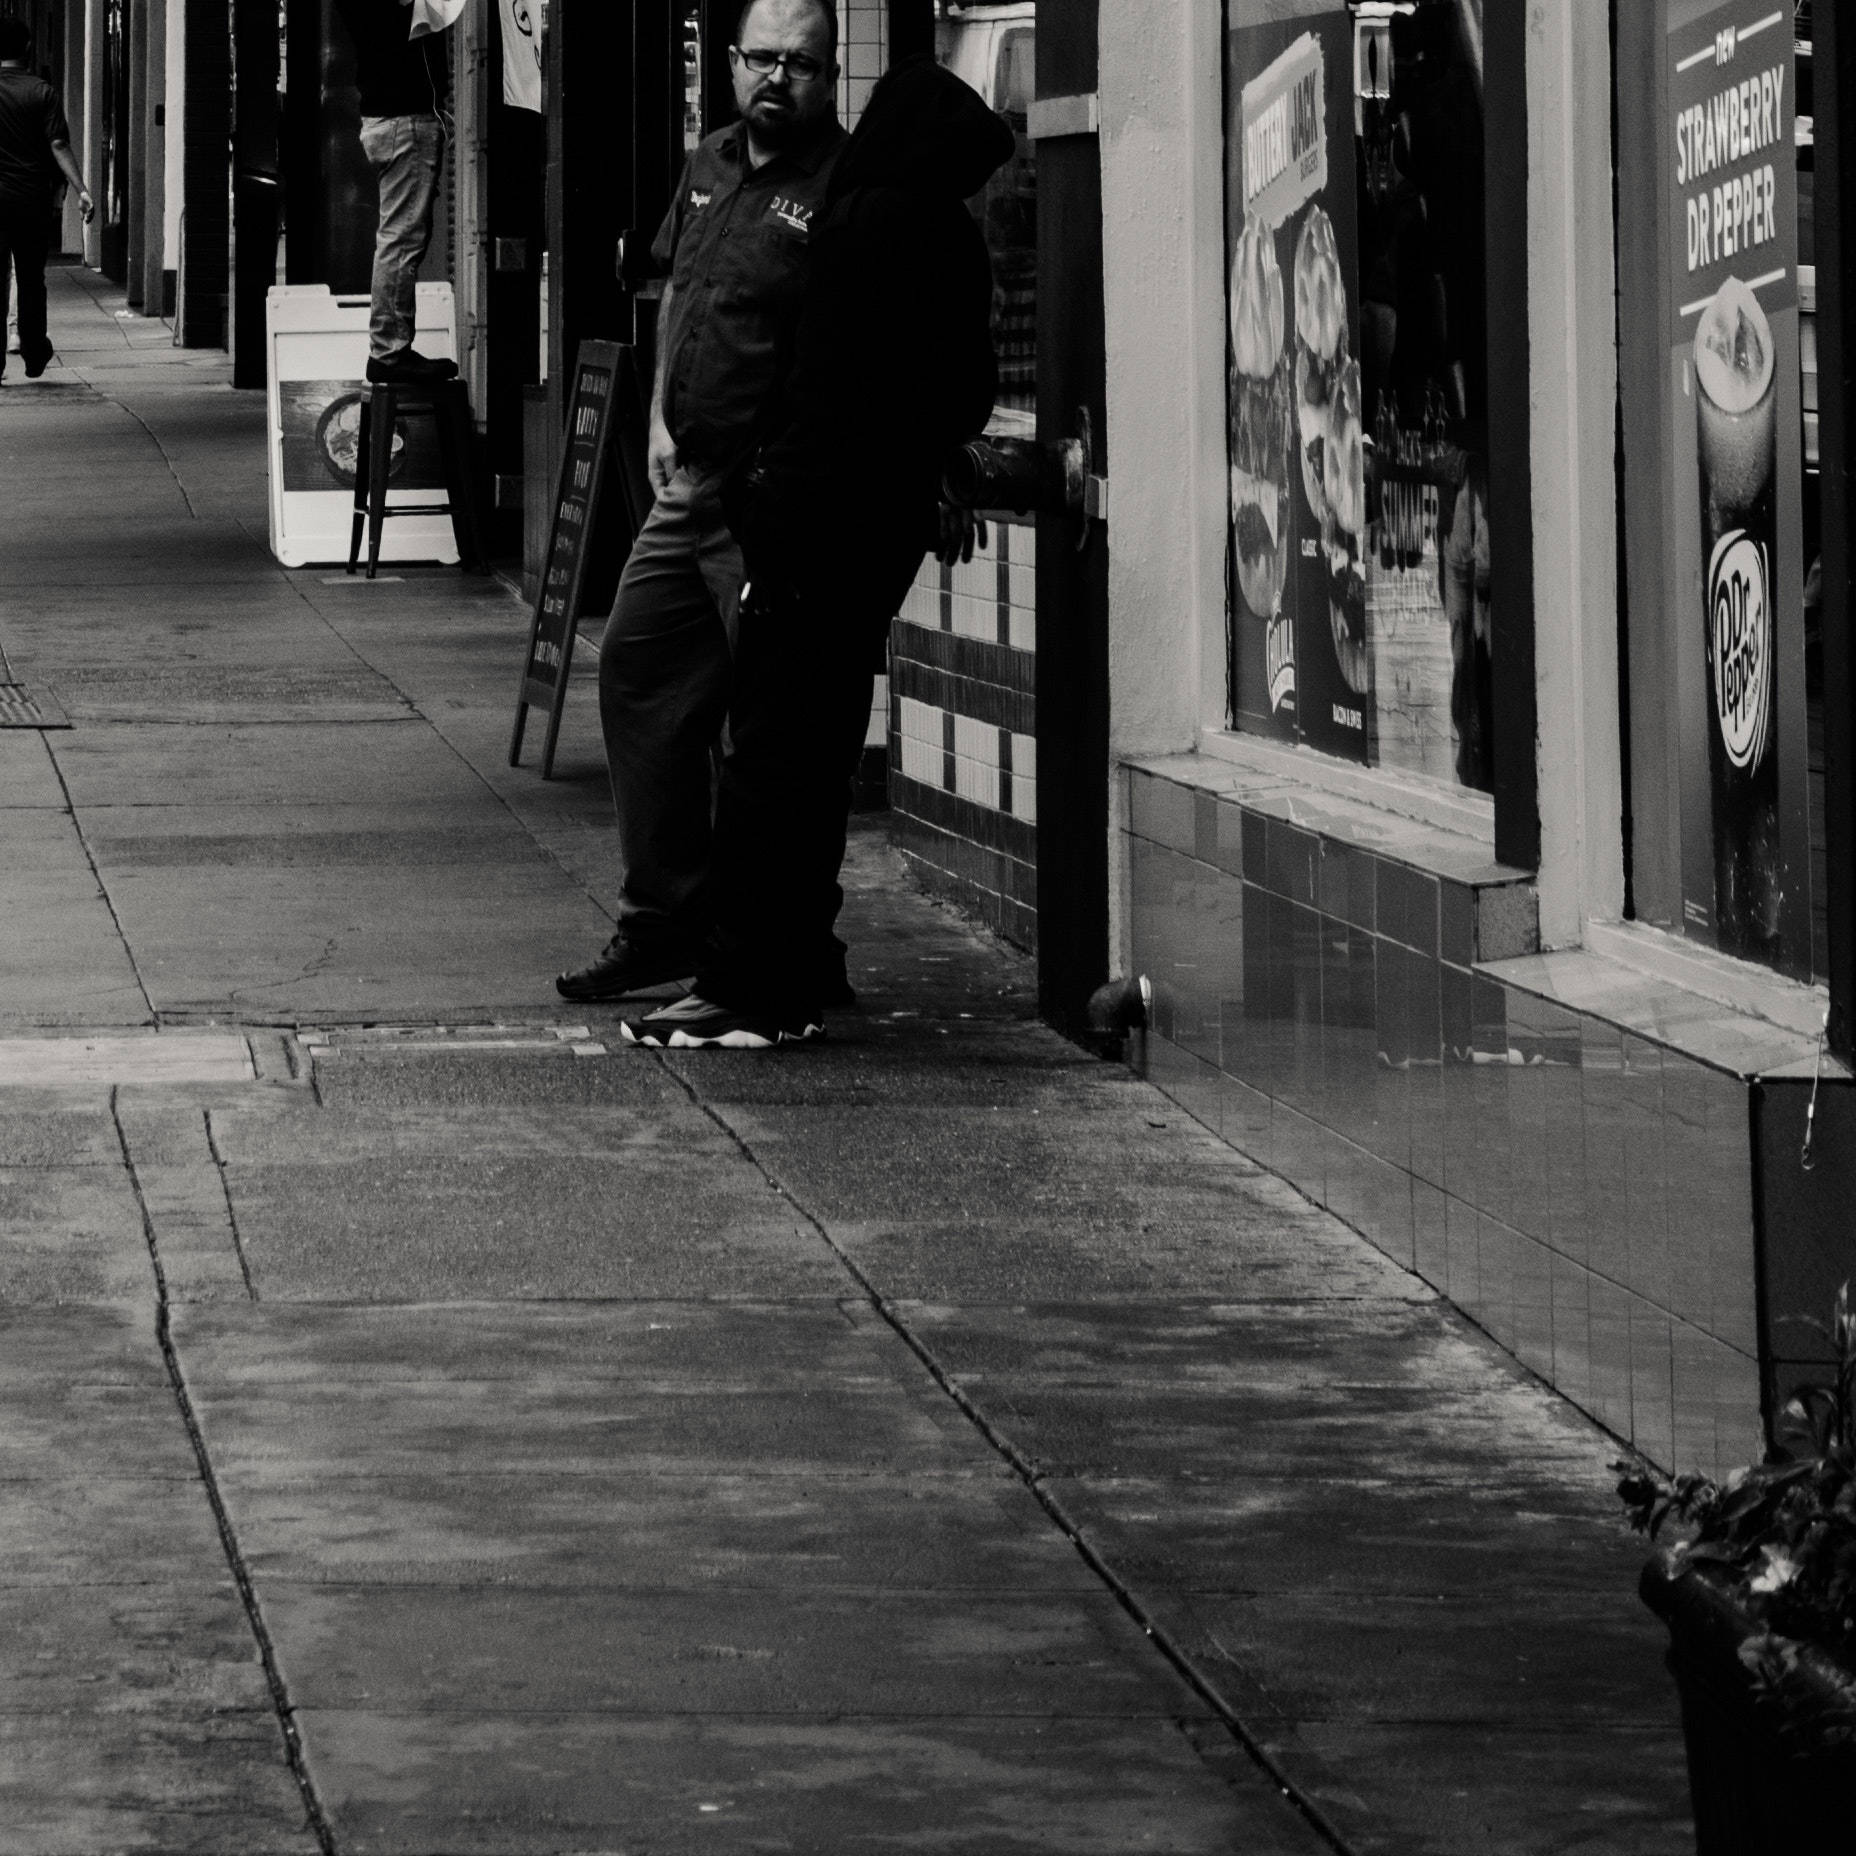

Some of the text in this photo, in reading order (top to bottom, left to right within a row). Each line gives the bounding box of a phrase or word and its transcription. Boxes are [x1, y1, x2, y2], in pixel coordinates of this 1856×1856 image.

[1291, 67, 1318, 163] JACK
[1676, 63, 1784, 185] STRAWBERRY
[1687, 164, 1776, 272] DR PEPPER
[1715, 579, 1762, 735] Pepper
